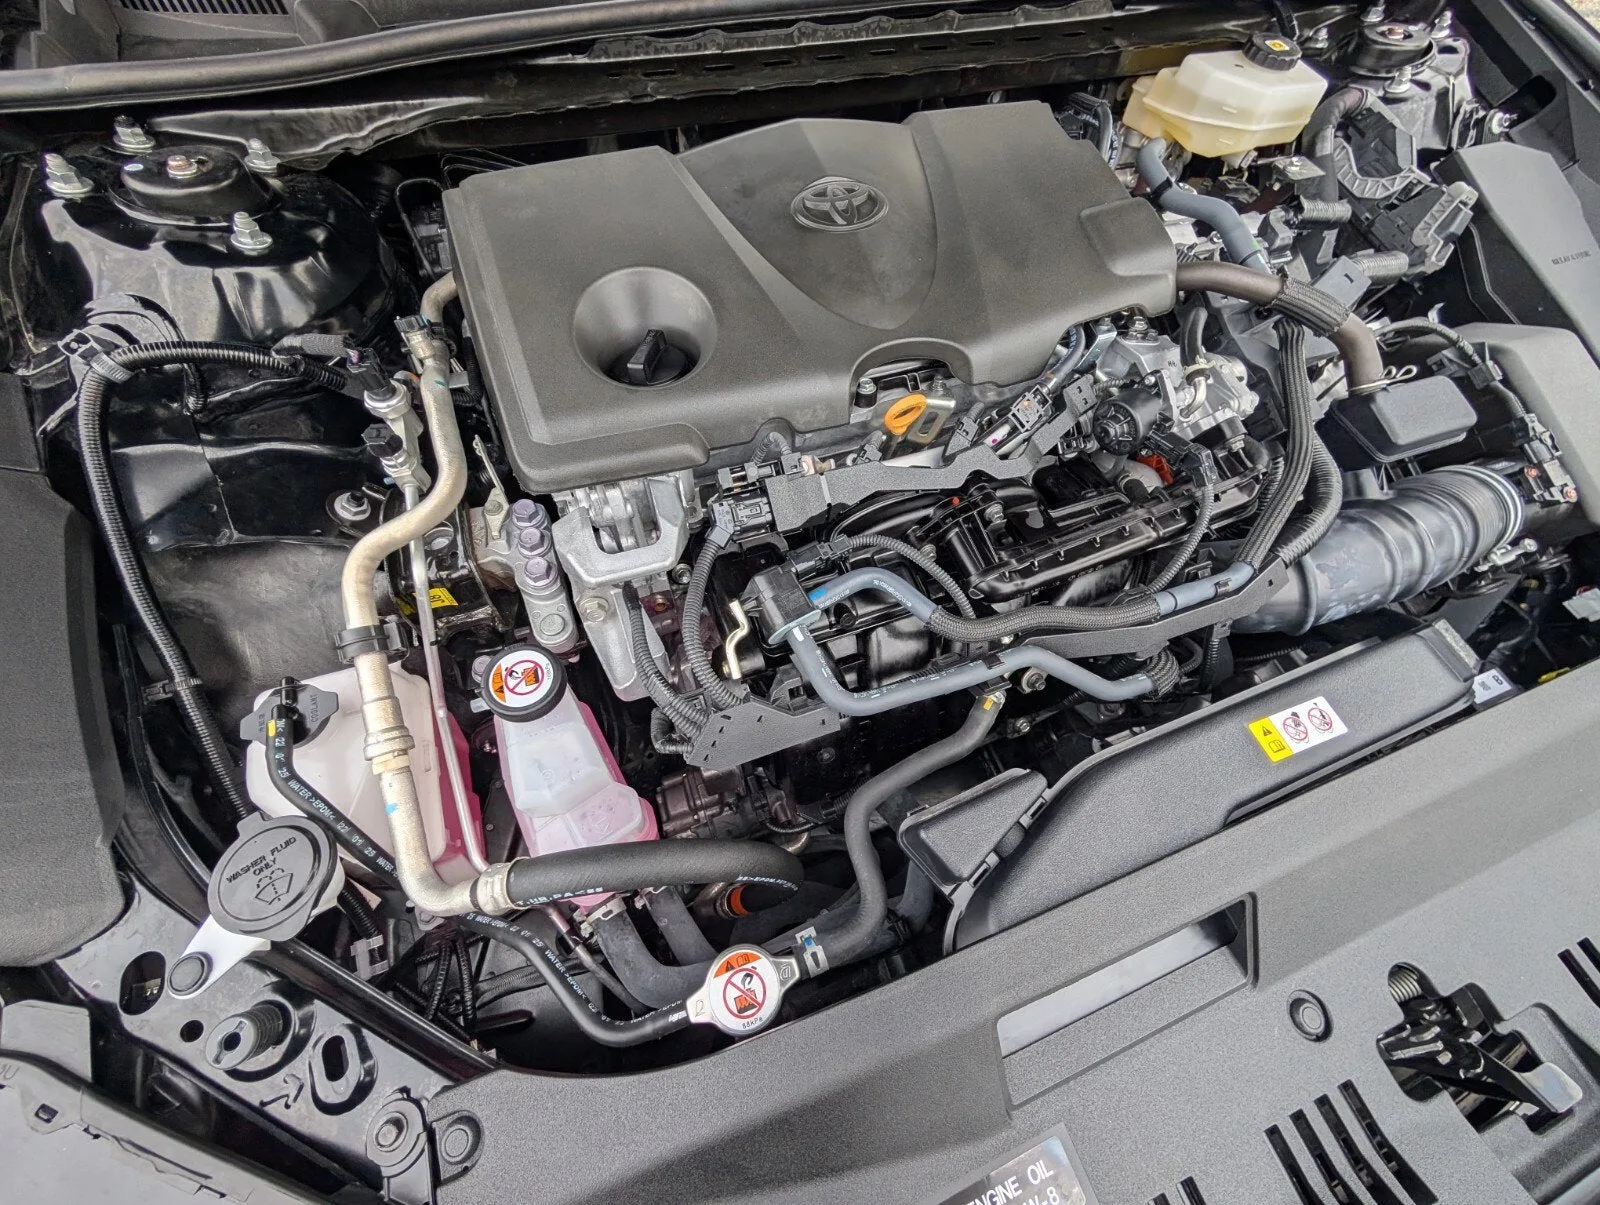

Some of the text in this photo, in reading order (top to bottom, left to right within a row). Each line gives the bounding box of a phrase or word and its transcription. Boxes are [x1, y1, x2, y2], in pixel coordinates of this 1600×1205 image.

[287, 779, 312, 801] WATER
[226, 836, 296, 883] WASHER FLUID
[253, 857, 277, 876] ONLY
[545, 950, 566, 973] WATER
[966, 1159, 1054, 1205] GINE OIL
